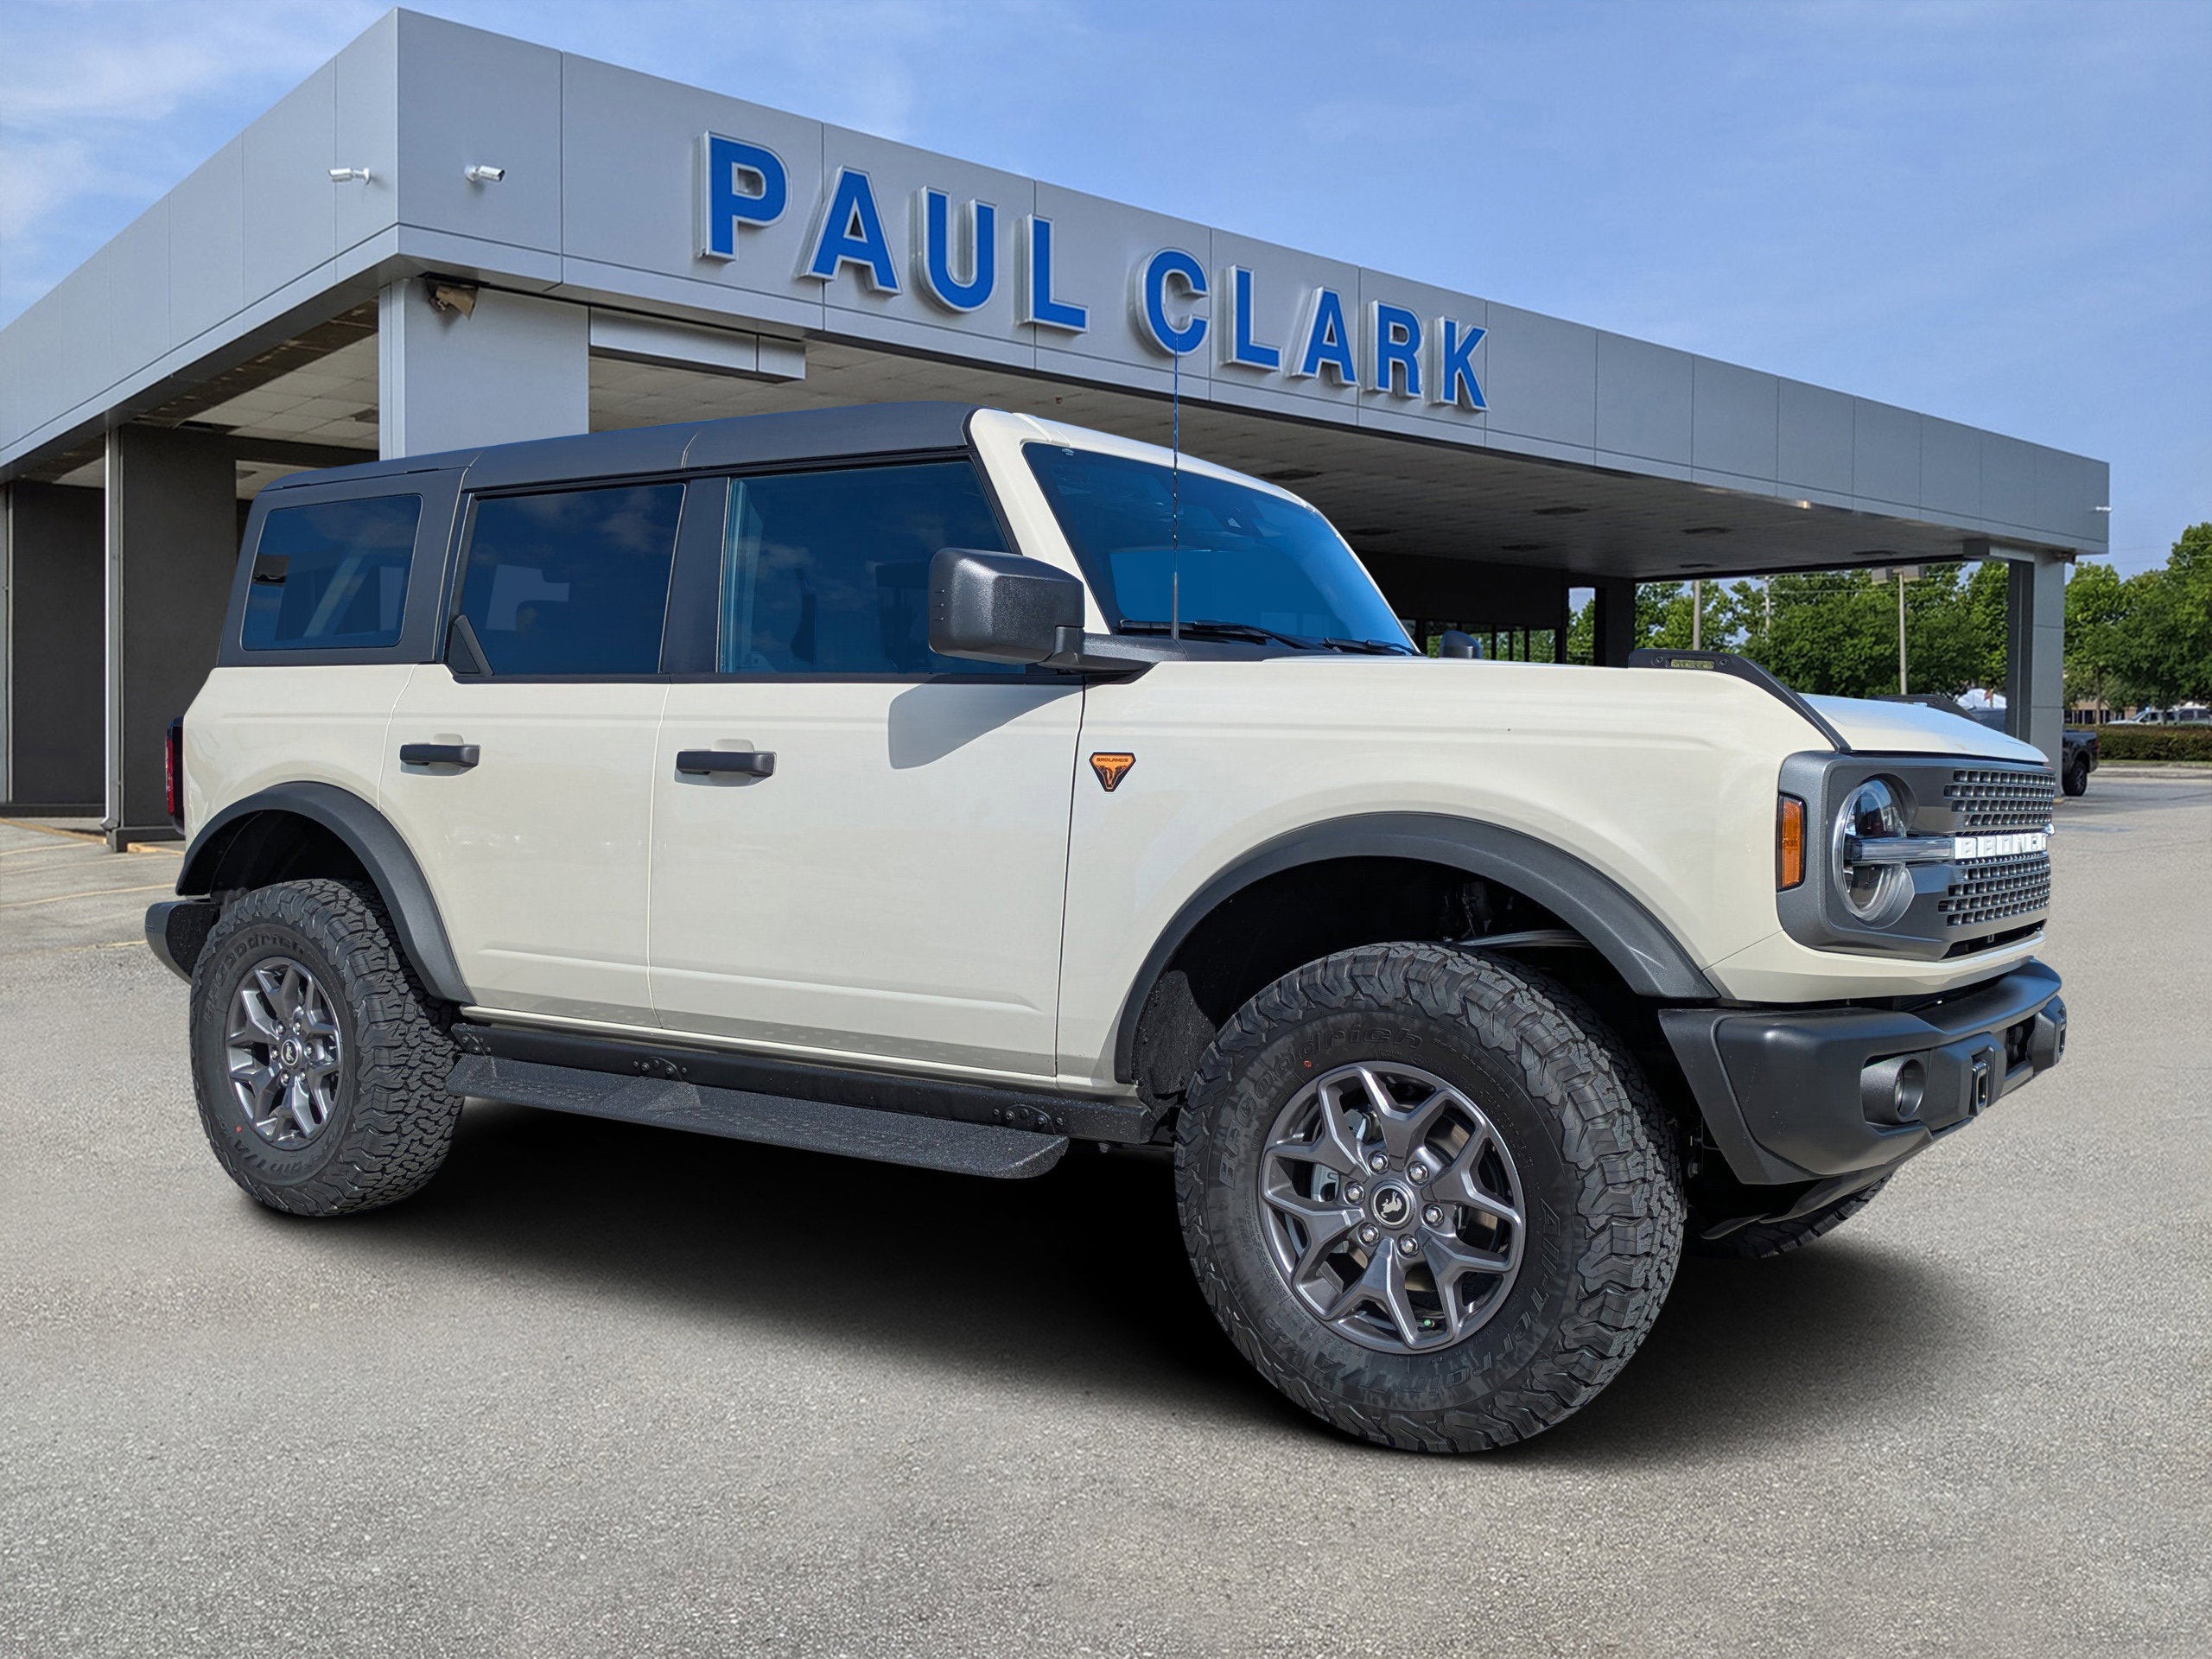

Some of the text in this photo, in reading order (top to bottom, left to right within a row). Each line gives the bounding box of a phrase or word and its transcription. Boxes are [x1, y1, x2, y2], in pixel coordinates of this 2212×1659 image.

[701, 130, 1490, 411] PAUL CLARK
[1217, 1023, 1424, 1190] BFGoodrich
